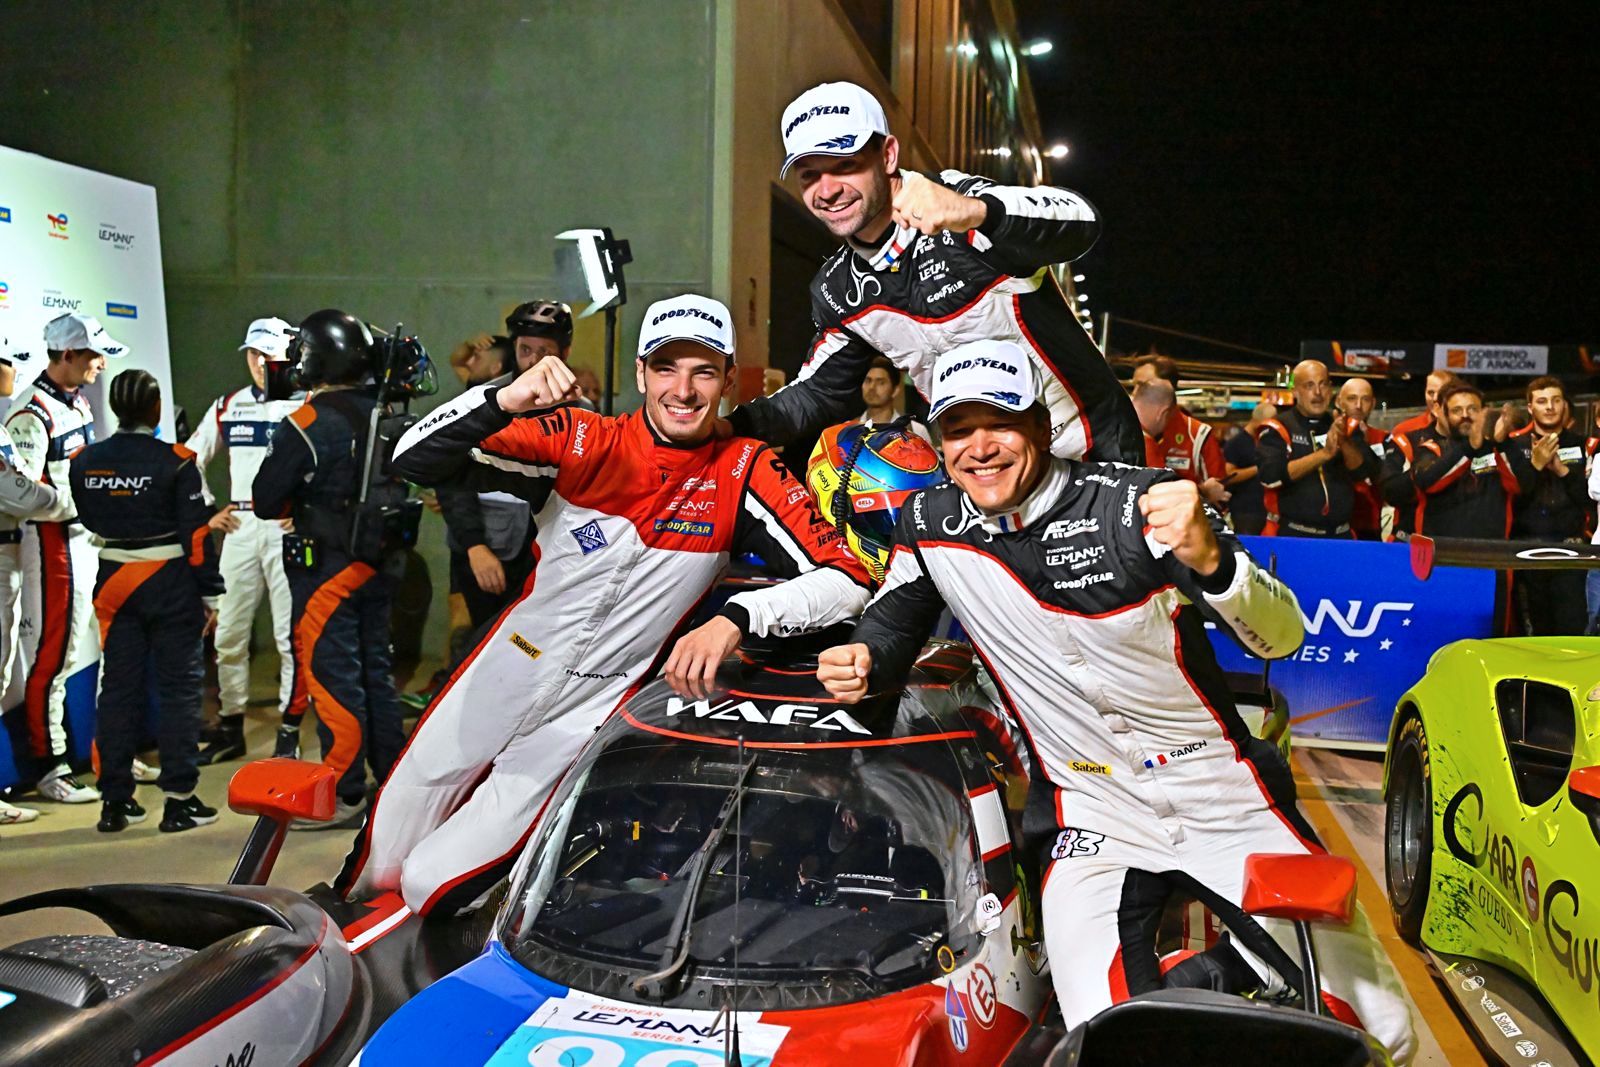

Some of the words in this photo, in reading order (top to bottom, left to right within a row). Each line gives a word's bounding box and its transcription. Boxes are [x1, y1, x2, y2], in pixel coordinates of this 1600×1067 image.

[821, 283, 846, 314] Sabelt
[652, 308, 723, 329] GOODYEAR
[939, 357, 1018, 382] GOODYEAR
[572, 420, 588, 455] Sabelt
[731, 444, 754, 480] Sabelt
[857, 498, 875, 507] BELL
[914, 492, 927, 530] Sabelt
[1046, 545, 1074, 554] EUROPEAN
[1053, 571, 1115, 590] GOODYEAR
[512, 635, 538, 657] Sabelt
[666, 697, 873, 736] WAFA
[1170, 739, 1207, 758] FANCH
[1072, 762, 1106, 774] Sabelt
[1050, 827, 1106, 860] 83
[1478, 885, 1512, 936] GUESS
[591, 1004, 664, 1017] EUROPEAN
[632, 1030, 685, 1042] SERIES
[952, 1018, 966, 1047] N
